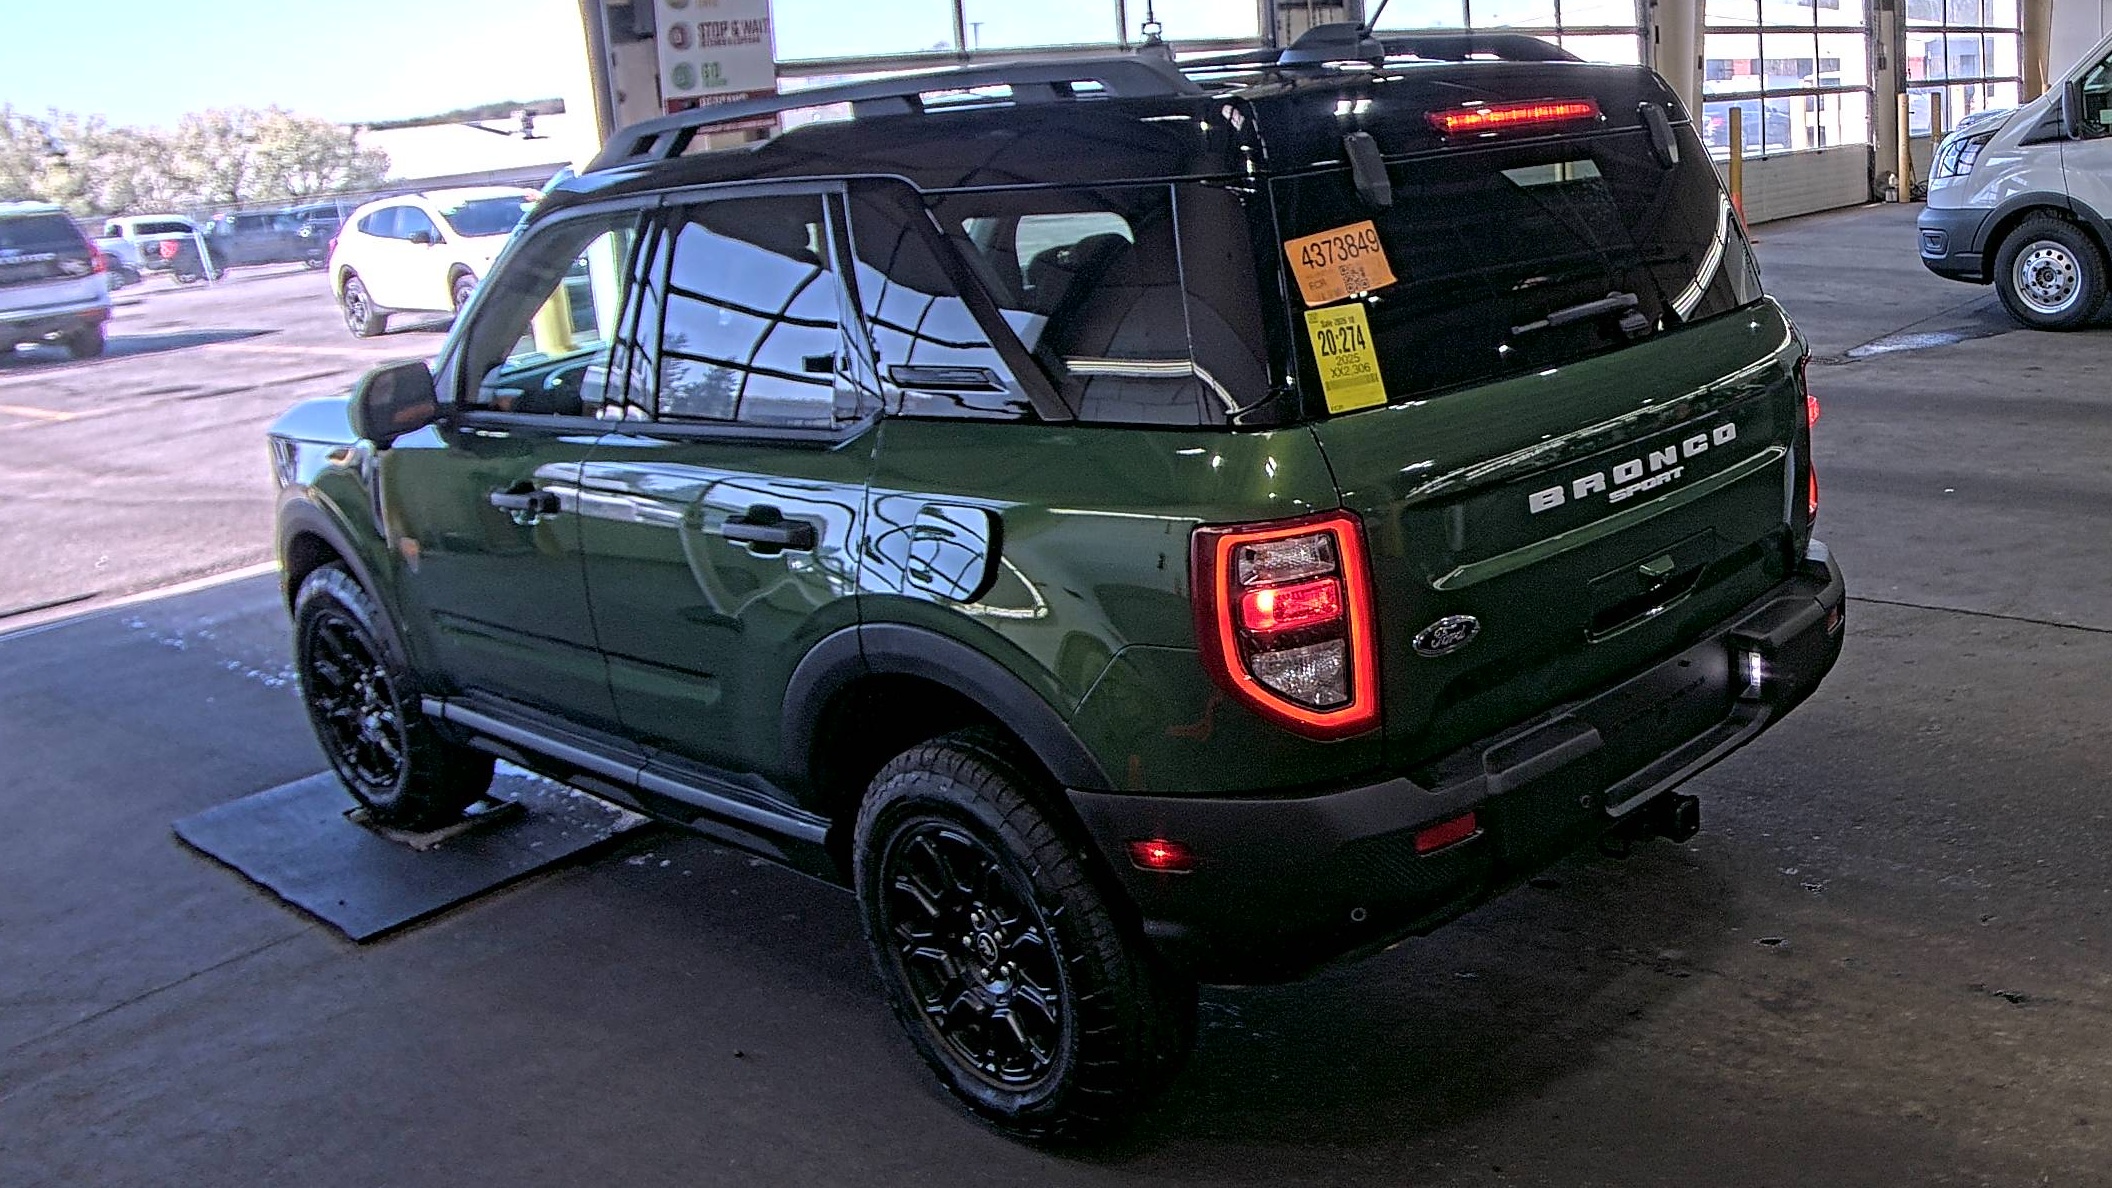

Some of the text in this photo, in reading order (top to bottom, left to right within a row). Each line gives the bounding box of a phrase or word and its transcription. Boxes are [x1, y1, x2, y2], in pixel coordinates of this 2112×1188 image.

[698, 20, 728, 39] STOP
[742, 18, 769, 35] WAIT
[1302, 228, 1379, 269] 4373849
[1335, 353, 1360, 366] 2025
[1352, 363, 1371, 374] 306
[1529, 423, 1736, 514] BRONCO
[1609, 466, 1684, 503] SPORT
